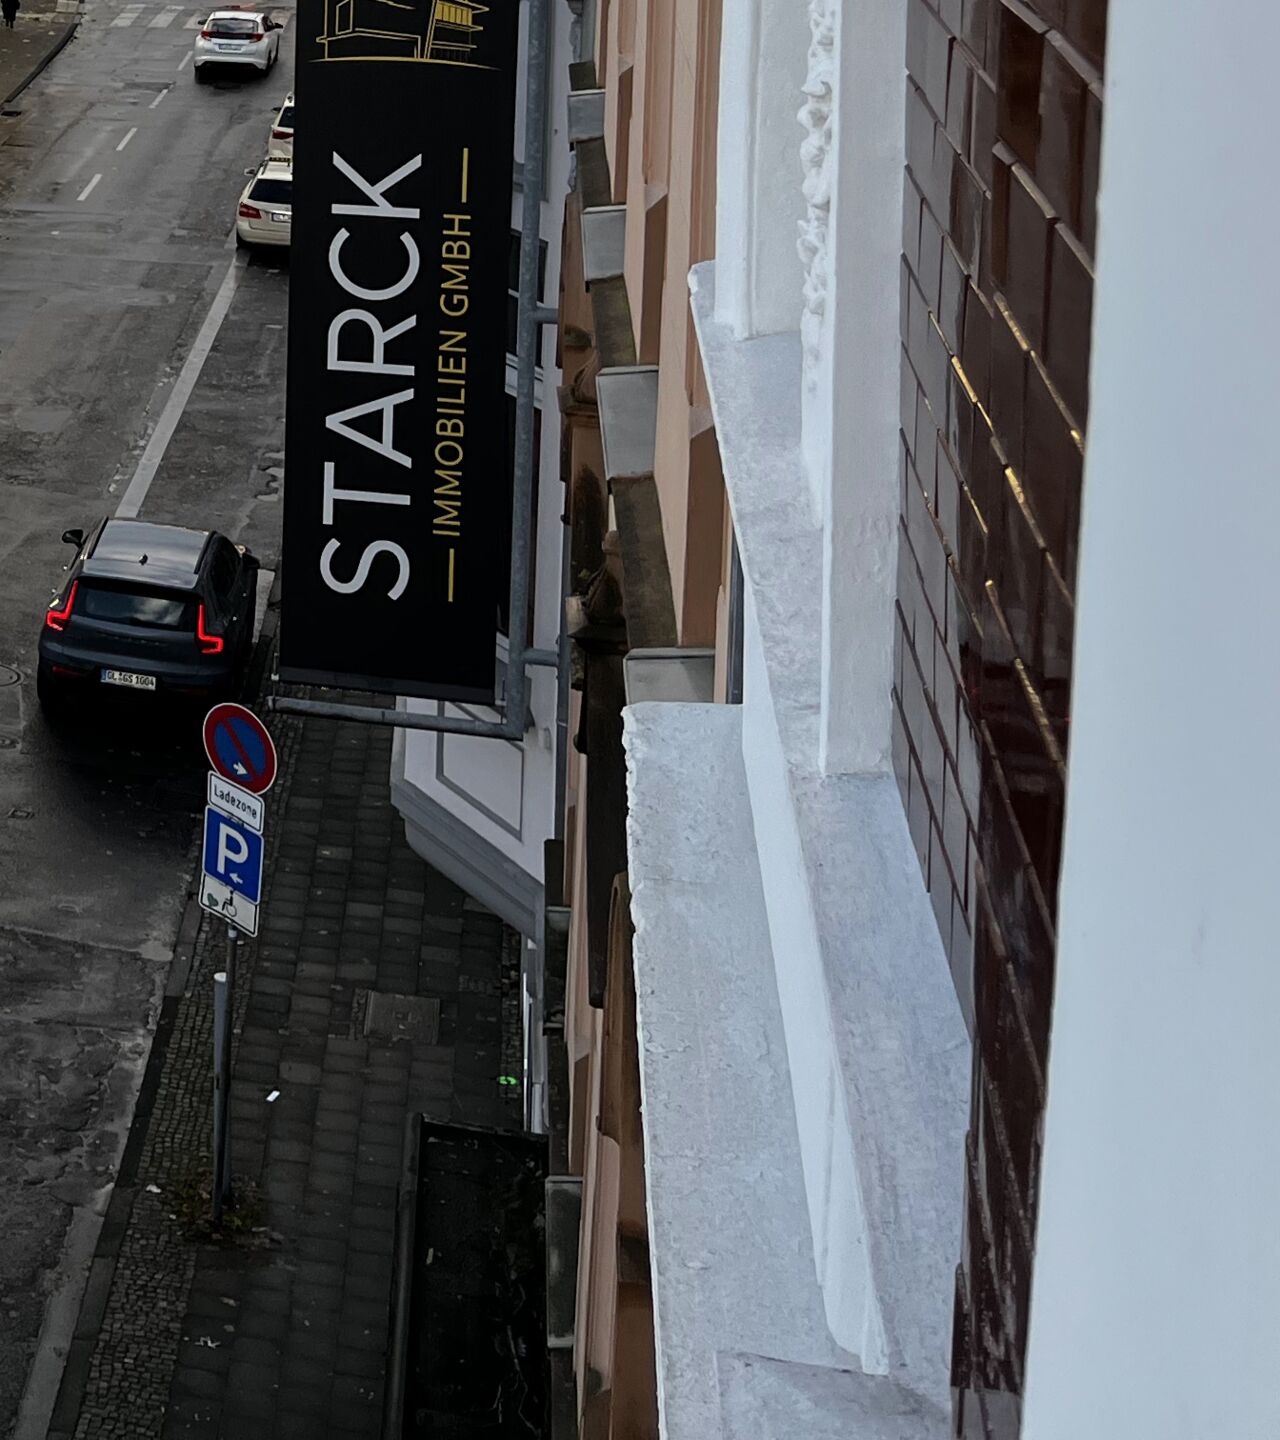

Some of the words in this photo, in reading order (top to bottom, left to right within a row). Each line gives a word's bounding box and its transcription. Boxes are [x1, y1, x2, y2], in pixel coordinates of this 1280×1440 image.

[440, 214, 472, 317] GMBH
[320, 151, 422, 600] STARCK
[432, 330, 467, 536] IMMOBILIEN
[214, 784, 257, 819] Ladezone
[217, 822, 248, 874] P
